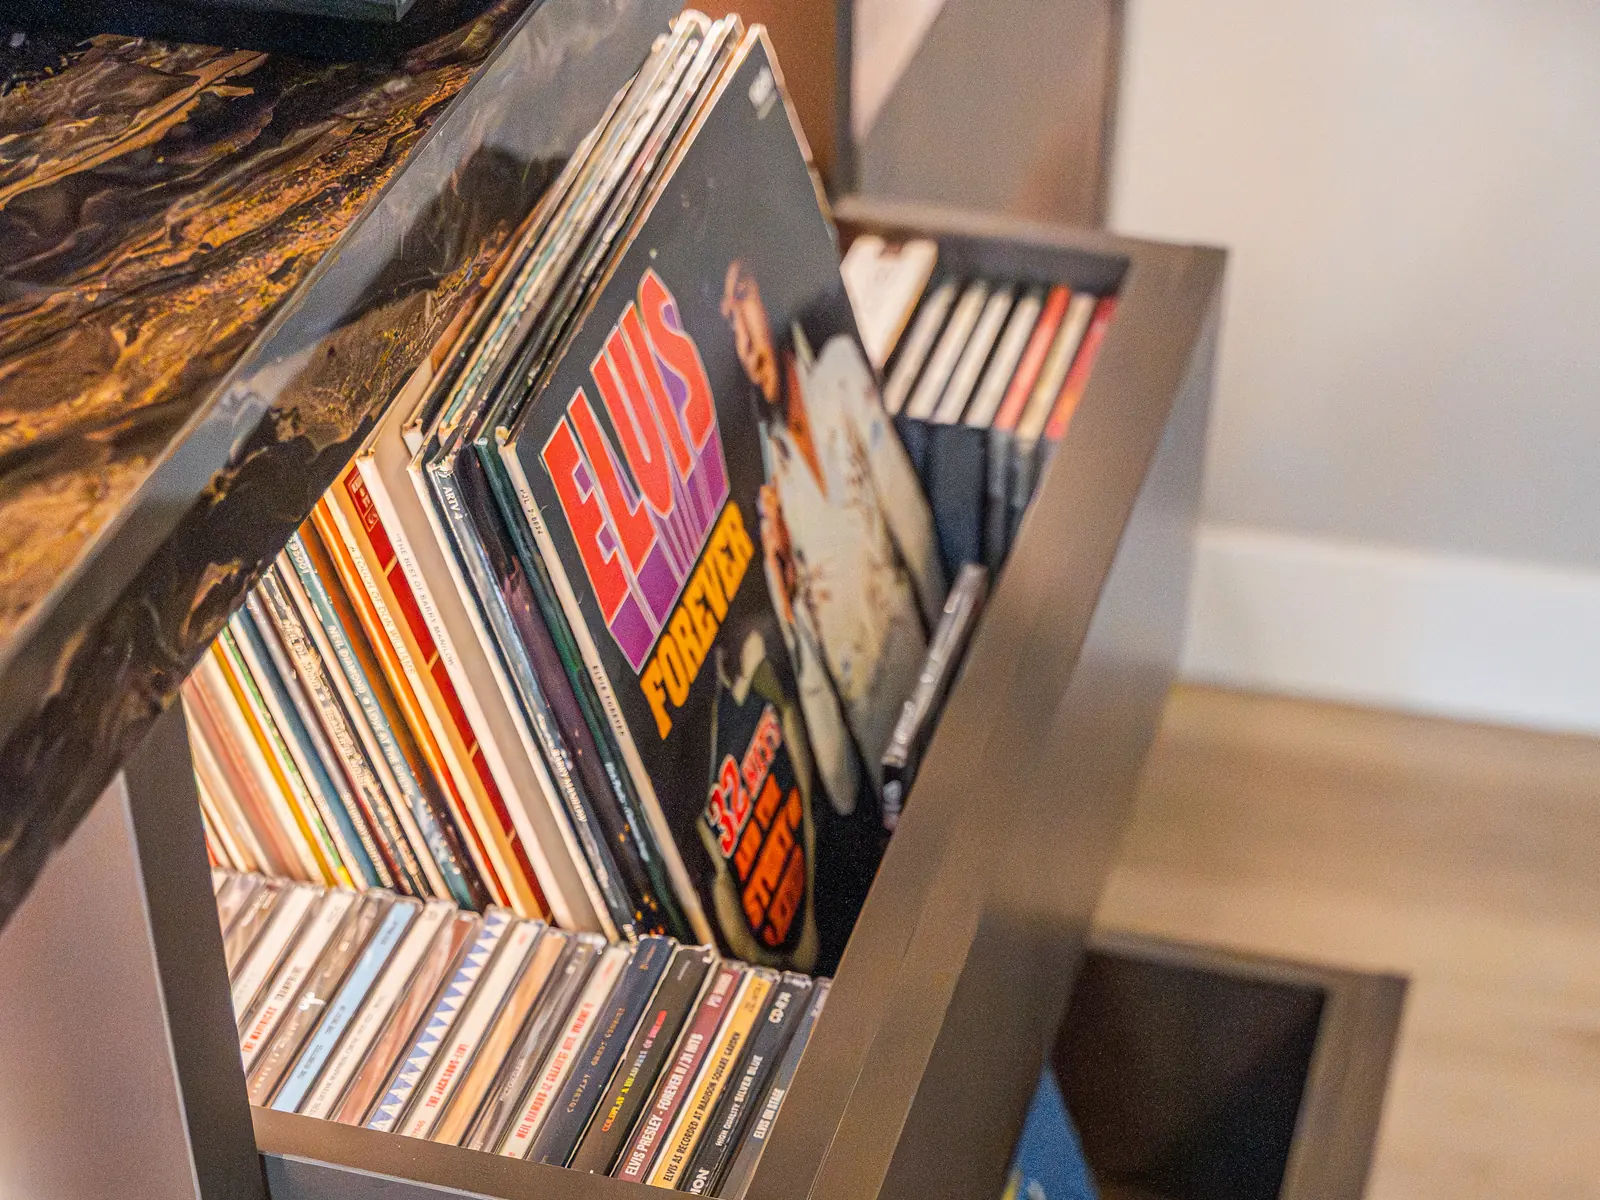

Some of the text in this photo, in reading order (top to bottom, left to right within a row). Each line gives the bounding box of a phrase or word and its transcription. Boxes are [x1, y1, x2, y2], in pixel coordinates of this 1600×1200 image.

[443, 485, 460, 511] ARTV
[541, 267, 729, 655] ELVIS
[328, 626, 344, 648] NEIL
[338, 647, 366, 694] DIAMOND
[640, 500, 755, 741] FOREVER
[704, 753, 751, 858] 32
[426, 1095, 439, 1107] THE
[515, 1123, 530, 1138] NEIL
[601, 1095, 625, 1132] COLDPLAY
[625, 1151, 645, 1175] ELVIS
[636, 1114, 663, 1151] PRESLEY
[657, 1073, 683, 1110] FOREVER
[663, 1031, 740, 1181] ELVIS AS RECORDED AT MADISON SQUARE GARDEN
[714, 1129, 728, 1146] HIGH
[723, 1102, 740, 1129] QUALITY
[734, 1075, 753, 1102] SILVER
[746, 1054, 762, 1075] BLUE
[753, 1118, 770, 1138] ELVIS
[767, 1087, 784, 1109] STAGE
